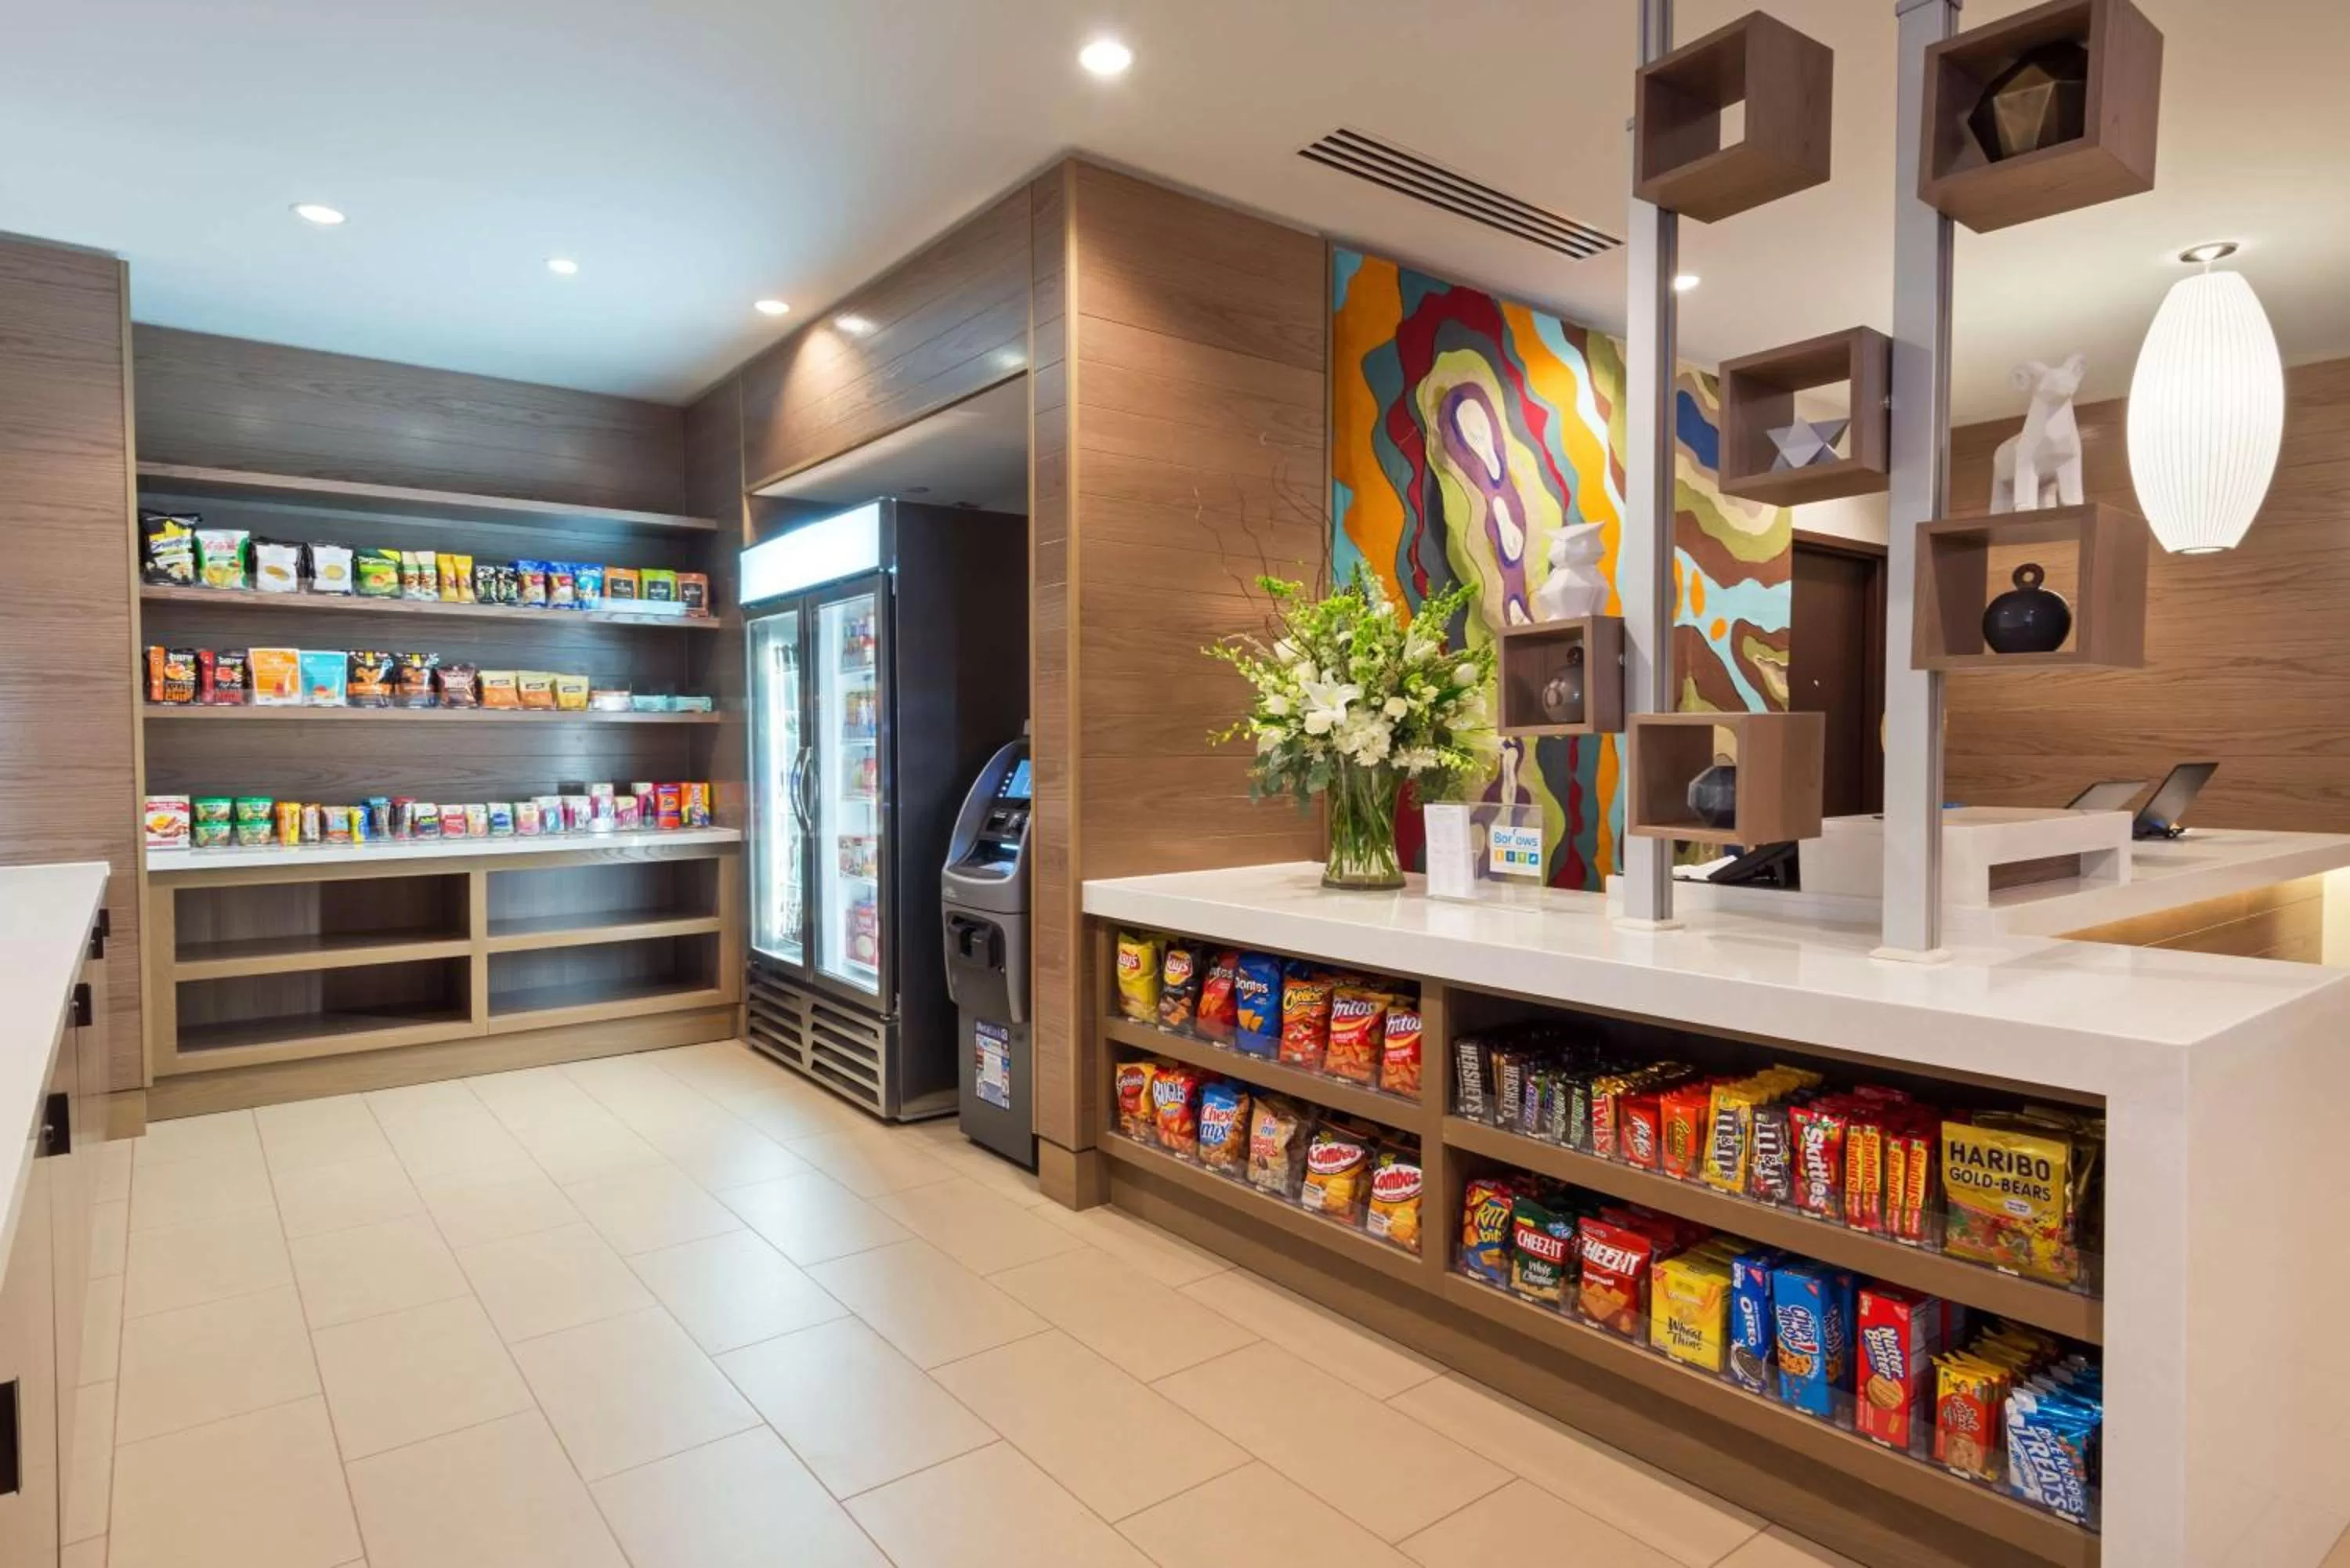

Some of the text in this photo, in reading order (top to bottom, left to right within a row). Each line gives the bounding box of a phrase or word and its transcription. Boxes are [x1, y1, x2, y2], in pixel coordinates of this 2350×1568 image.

[1460, 1044, 1483, 1114] HERSHEY'S
[1803, 1125, 1831, 1208] Skittles
[1949, 1166, 2052, 1201] GOLD-BEARS
[1950, 1140, 2051, 1182] HARIBO
[1517, 1229, 1564, 1259] CHEEZ-IT
[1740, 1296, 1756, 1346] OREO
[1790, 1303, 1814, 1346] Chips
[1864, 1328, 1893, 1380] Butter
[1878, 1327, 1905, 1379] Nutter
[2012, 1425, 2067, 1508] TREATS
